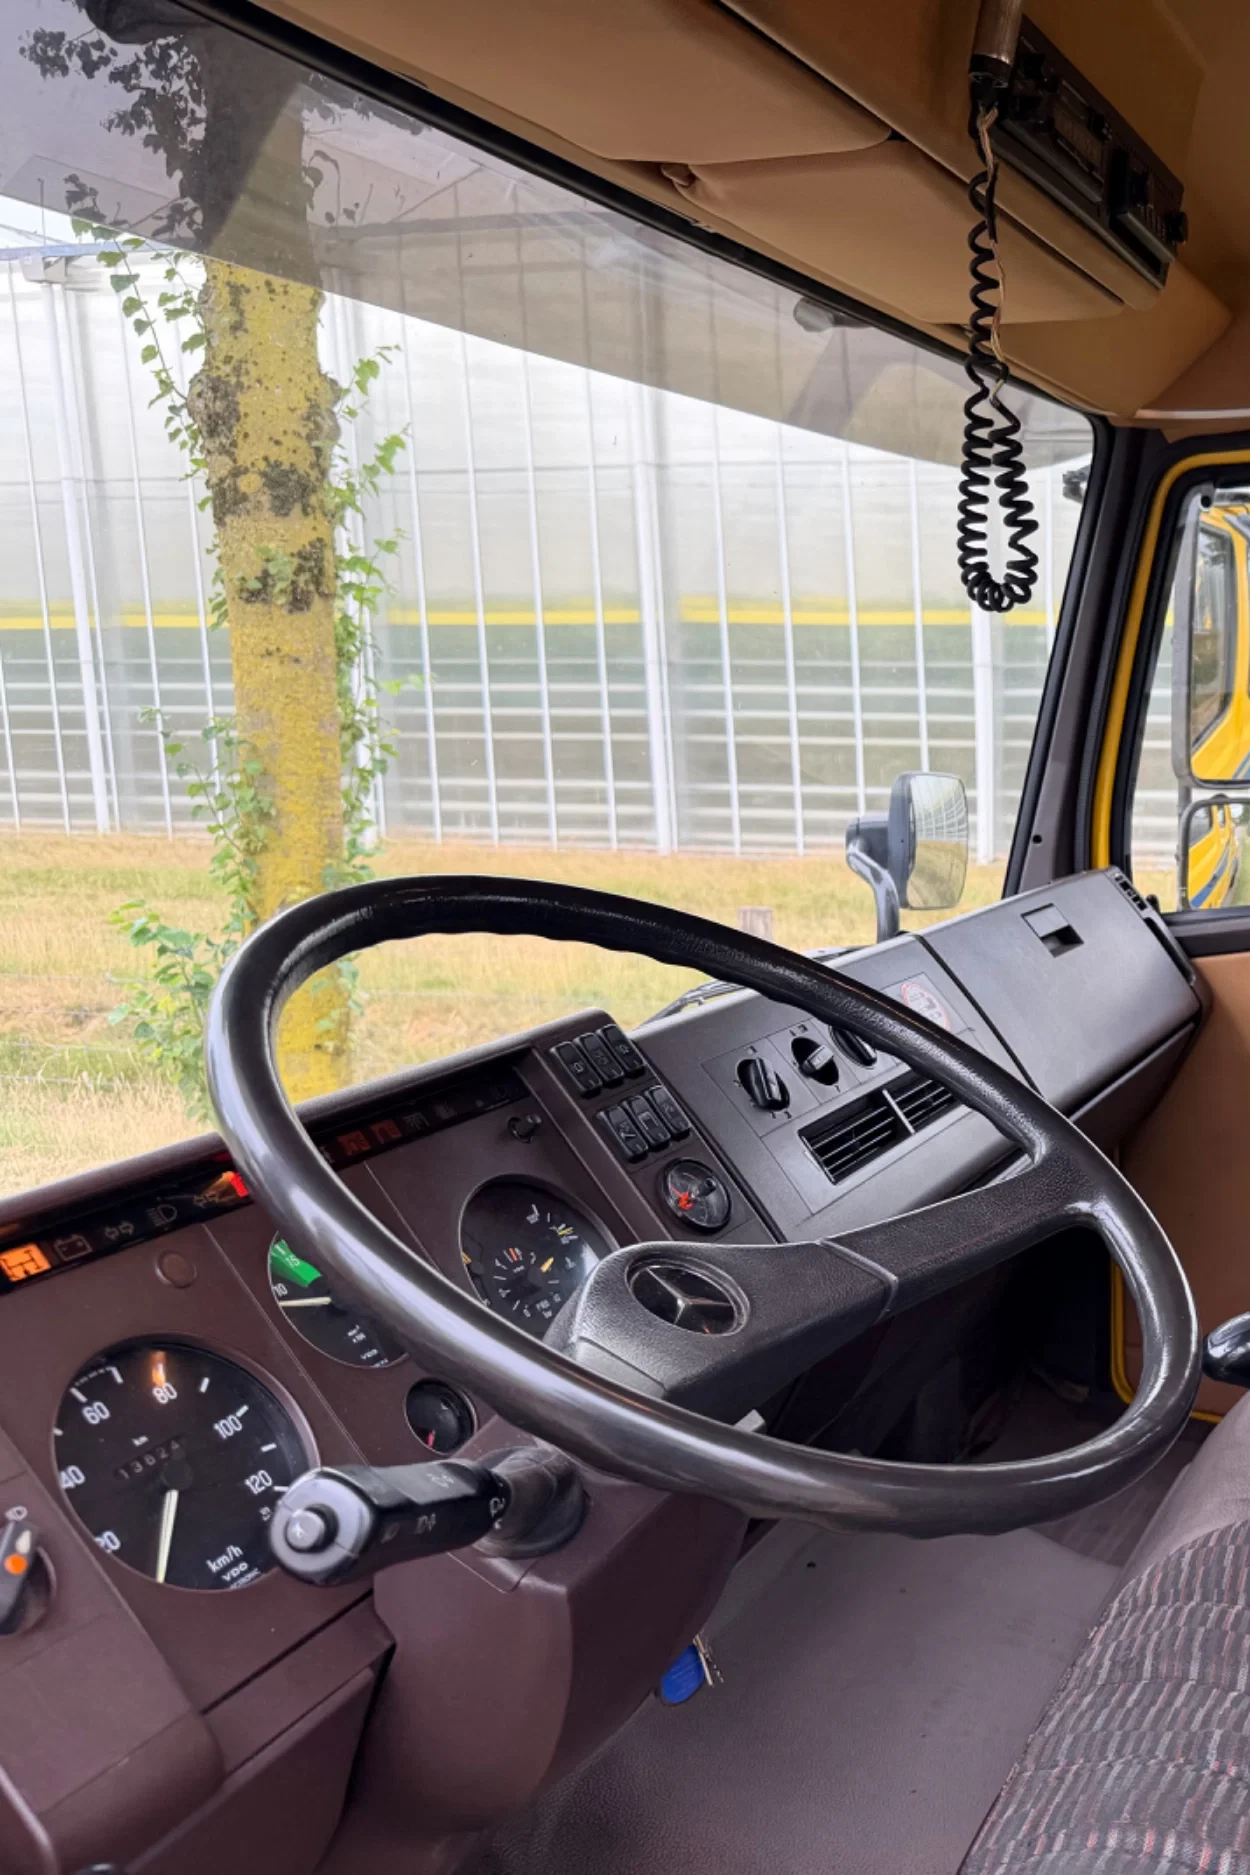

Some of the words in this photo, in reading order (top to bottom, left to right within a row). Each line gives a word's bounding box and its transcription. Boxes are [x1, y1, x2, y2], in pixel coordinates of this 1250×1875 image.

[152, 1382, 178, 1404] 80
[82, 1401, 110, 1424] 60
[213, 1414, 242, 1439] 100
[60, 1465, 85, 1488] 40
[245, 1470, 272, 1494] 120
[206, 1545, 244, 1573] km/h
[222, 1561, 248, 1581] VDO
